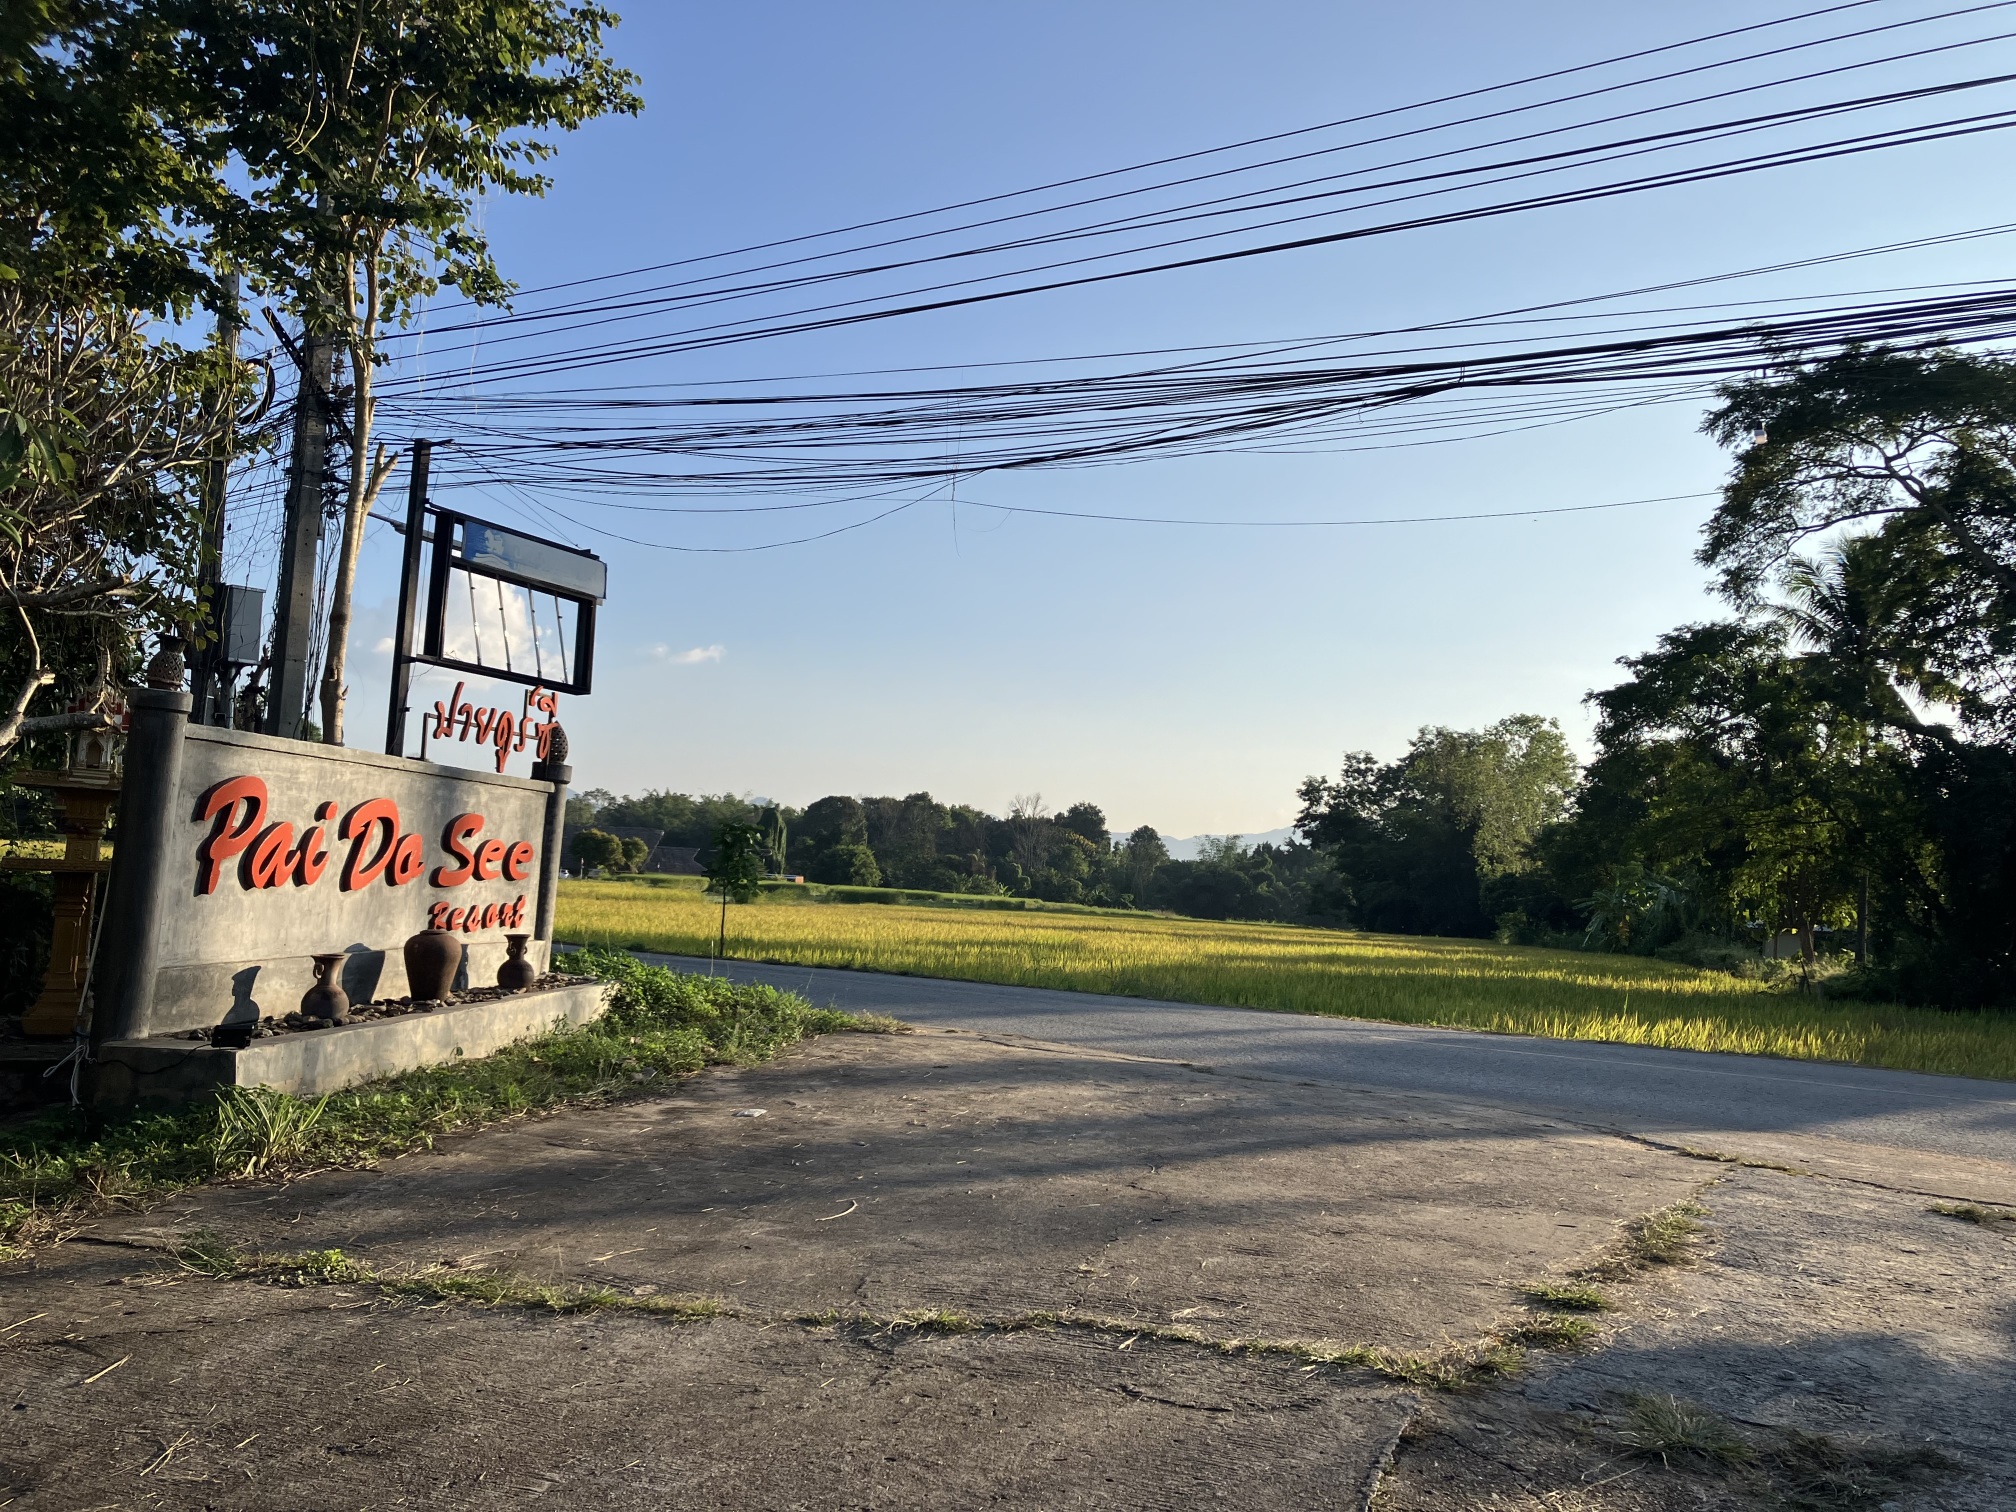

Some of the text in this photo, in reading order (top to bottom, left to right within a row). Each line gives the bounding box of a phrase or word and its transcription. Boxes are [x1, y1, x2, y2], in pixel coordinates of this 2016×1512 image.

[196, 775, 338, 896] Pai
[431, 813, 534, 888] See
[429, 895, 527, 933] Resort
